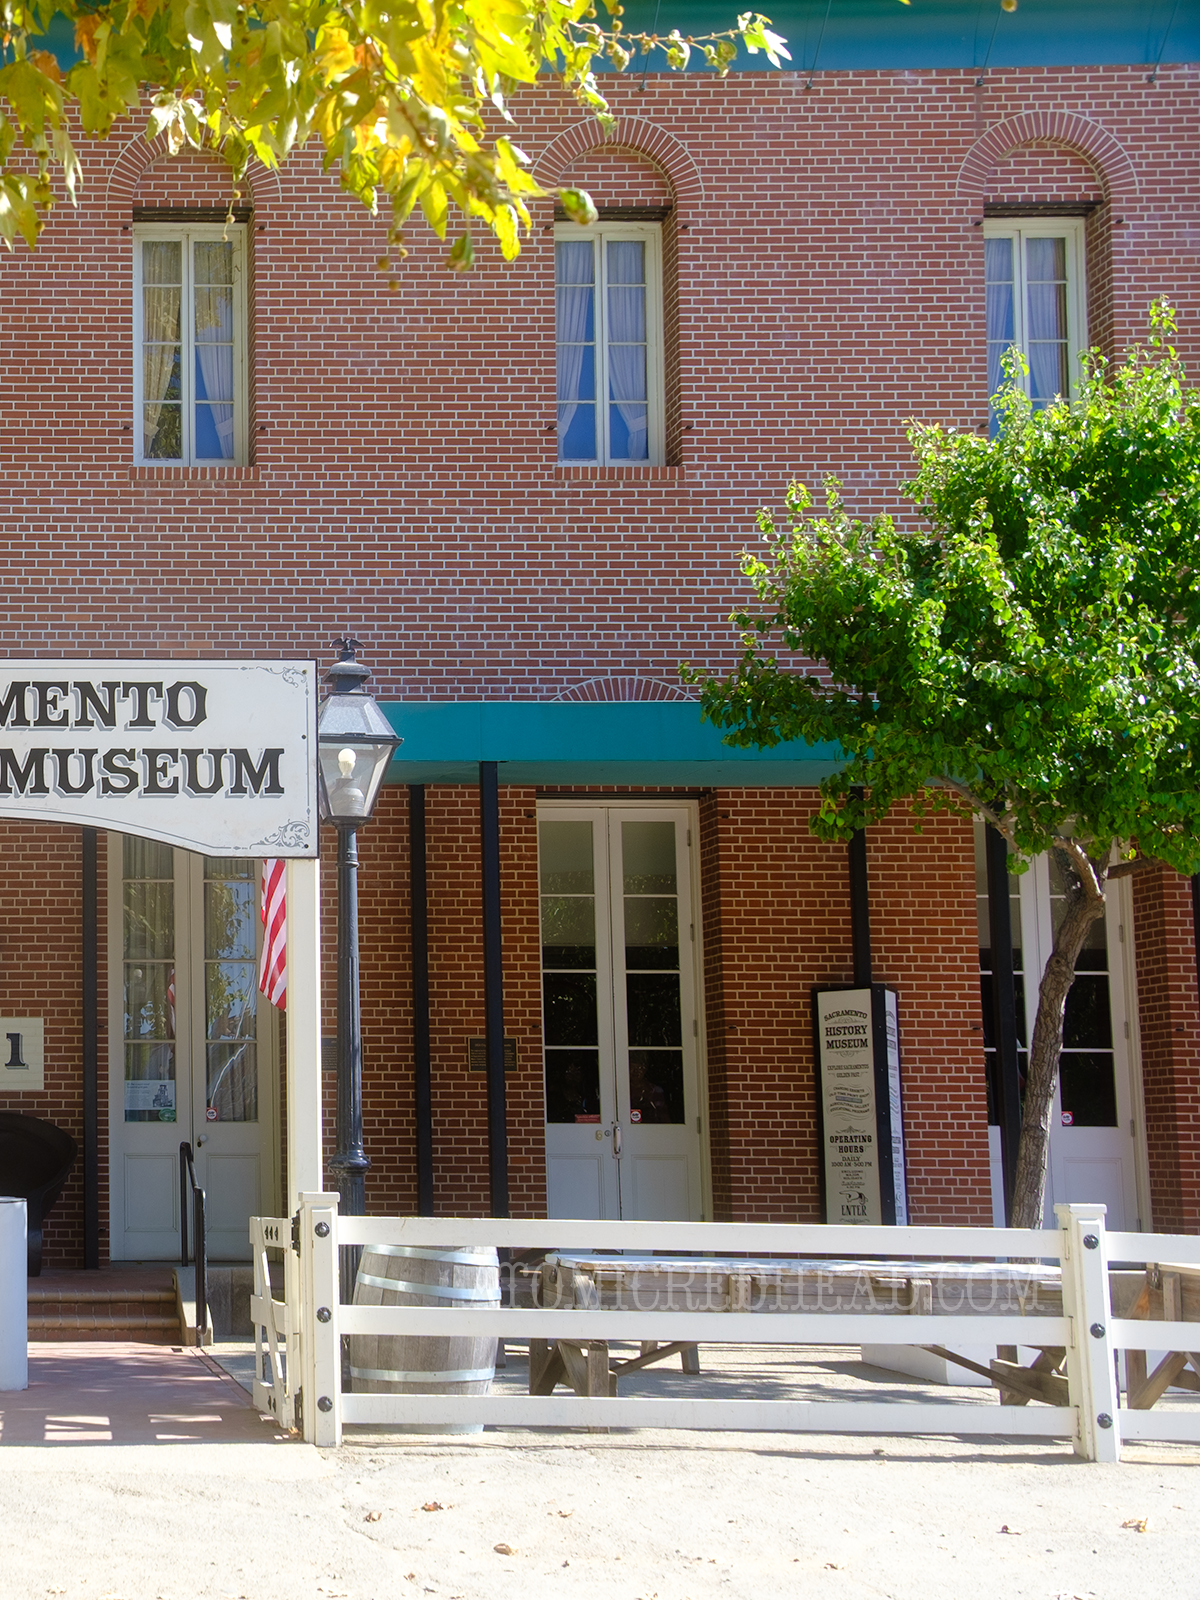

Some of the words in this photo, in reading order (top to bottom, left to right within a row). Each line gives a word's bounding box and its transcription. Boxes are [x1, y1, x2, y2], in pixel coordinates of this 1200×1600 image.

[824, 1009, 868, 1021] SACRAMENTO
[825, 1025, 868, 1036] HISTORY
[826, 1038, 869, 1049] MUSEUM
[830, 1135, 872, 1143] OPERATING
[838, 1145, 864, 1153] HOURS
[841, 1204, 867, 1216] ENTER
